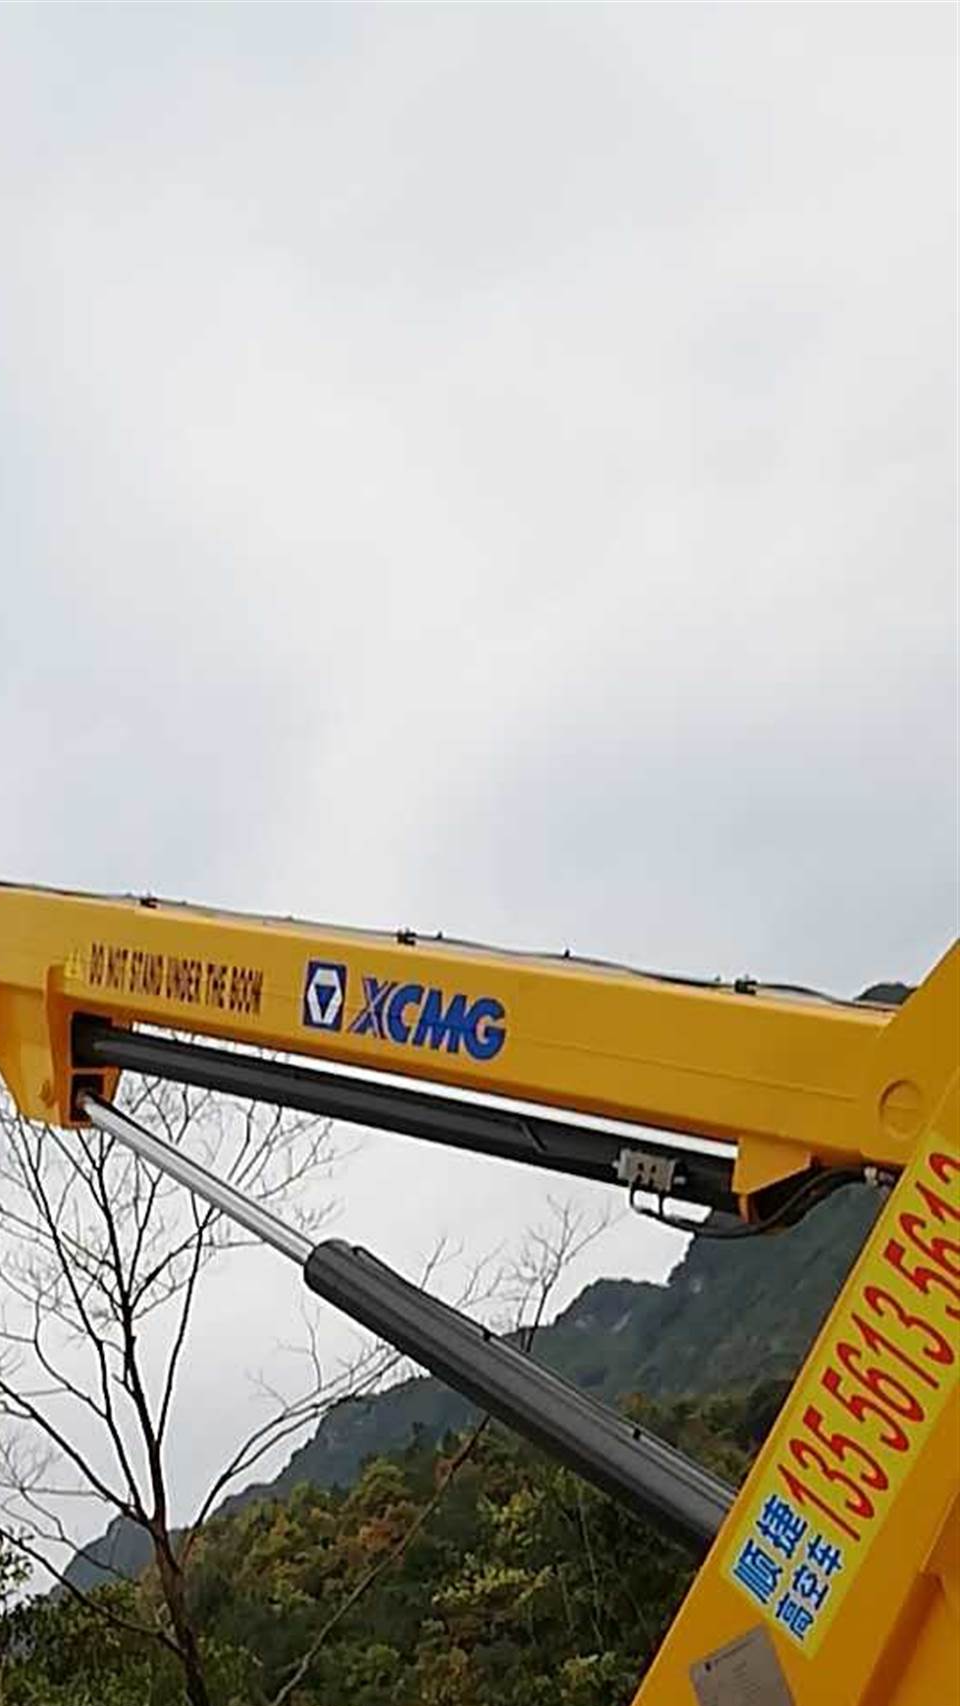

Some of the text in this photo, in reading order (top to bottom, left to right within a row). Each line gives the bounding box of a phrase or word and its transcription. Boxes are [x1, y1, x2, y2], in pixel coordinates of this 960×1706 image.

[90, 942, 264, 1015] DO NOT STAND UNDER THE BOOM
[349, 976, 507, 1060] XCMG
[733, 1494, 808, 1604] 顺捷
[776, 1534, 842, 1641] 高空车
